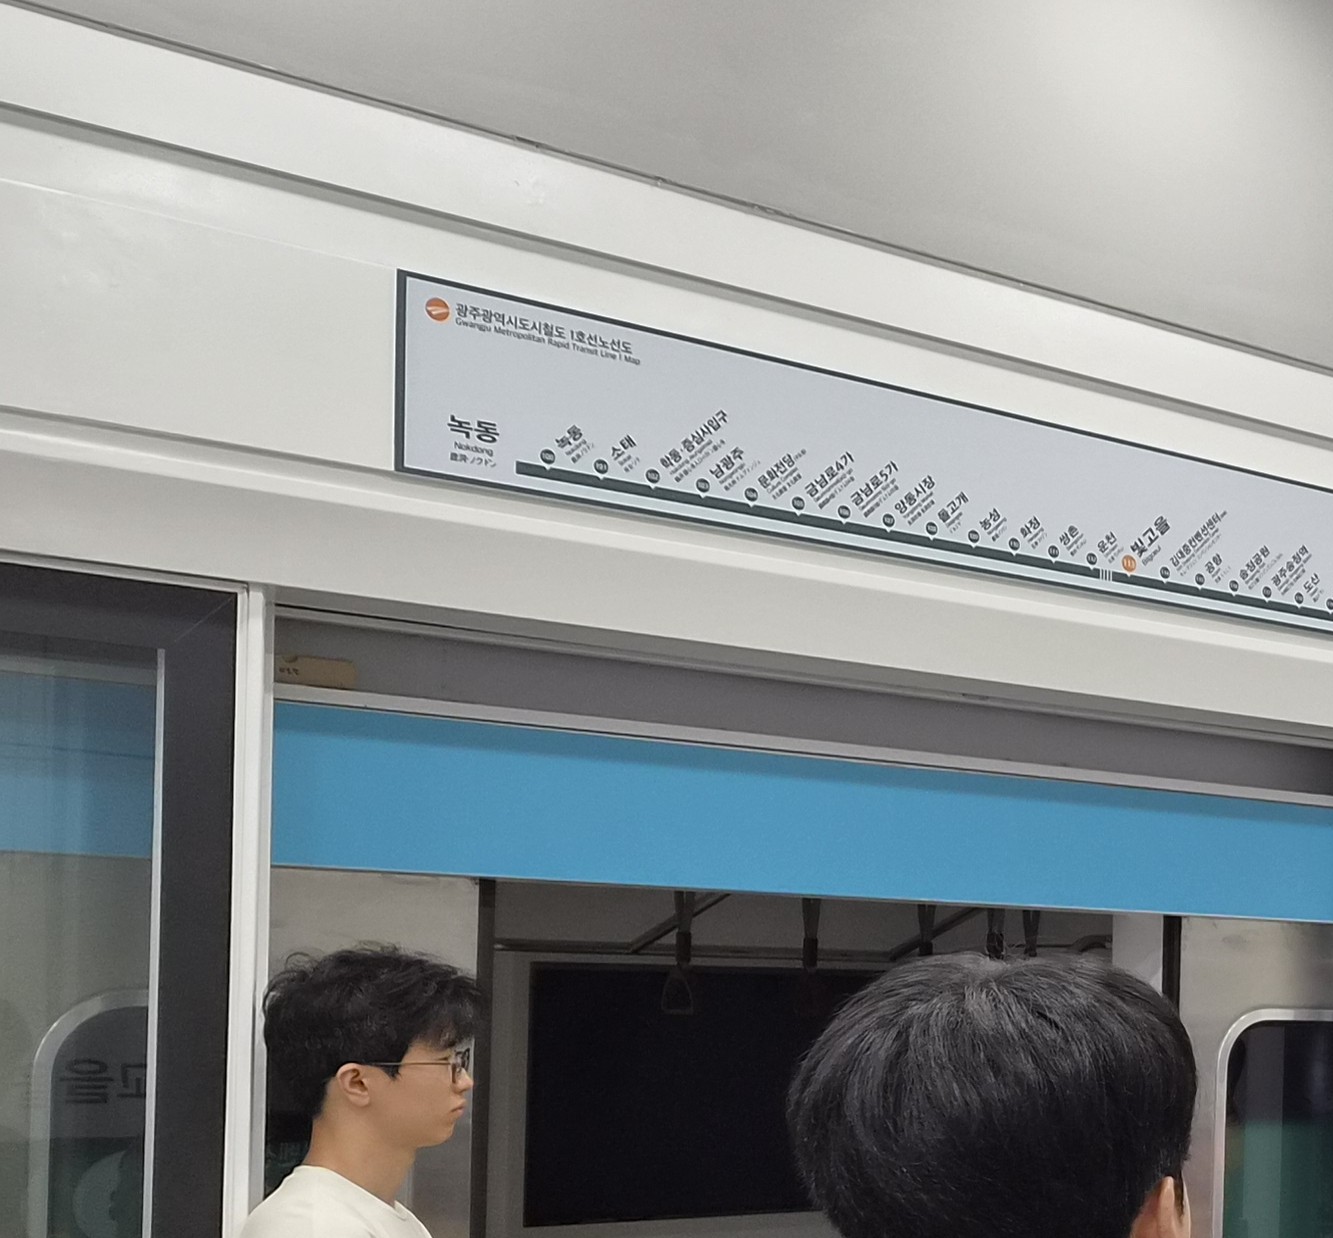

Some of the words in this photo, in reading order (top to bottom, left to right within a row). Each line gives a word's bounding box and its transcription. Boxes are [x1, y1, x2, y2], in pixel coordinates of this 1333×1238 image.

[455, 303, 566, 339] 광주광역시도시철도
[570, 330, 633, 354] 1호선노선도
[455, 318, 491, 333] Gwangju
[493, 326, 545, 344] Metropolitan
[547, 337, 570, 350] Rapid
[600, 349, 616, 360] Line
[624, 354, 641, 366] Map
[447, 415, 499, 443] 녹동
[555, 424, 583, 449] 녹동
[454, 441, 494, 457] Nokdong
[610, 434, 637, 461] 소태
[709, 446, 745, 479] 남광주
[757, 453, 796, 489] 문화전당
[804, 451, 854, 498] 금남로4가
[850, 460, 899, 507] 금남로5가
[894, 475, 936, 514] 양동시장
[979, 508, 1001, 531] 농성
[1020, 516, 1041, 538] 화정
[1098, 531, 1118, 554] 운천
[1130, 516, 1171, 558] 빛고을
[1170, 512, 1222, 567] 김대중컨벤션센터
[1205, 553, 1223, 574] 공항
[1303, 573, 1320, 594] 도산
